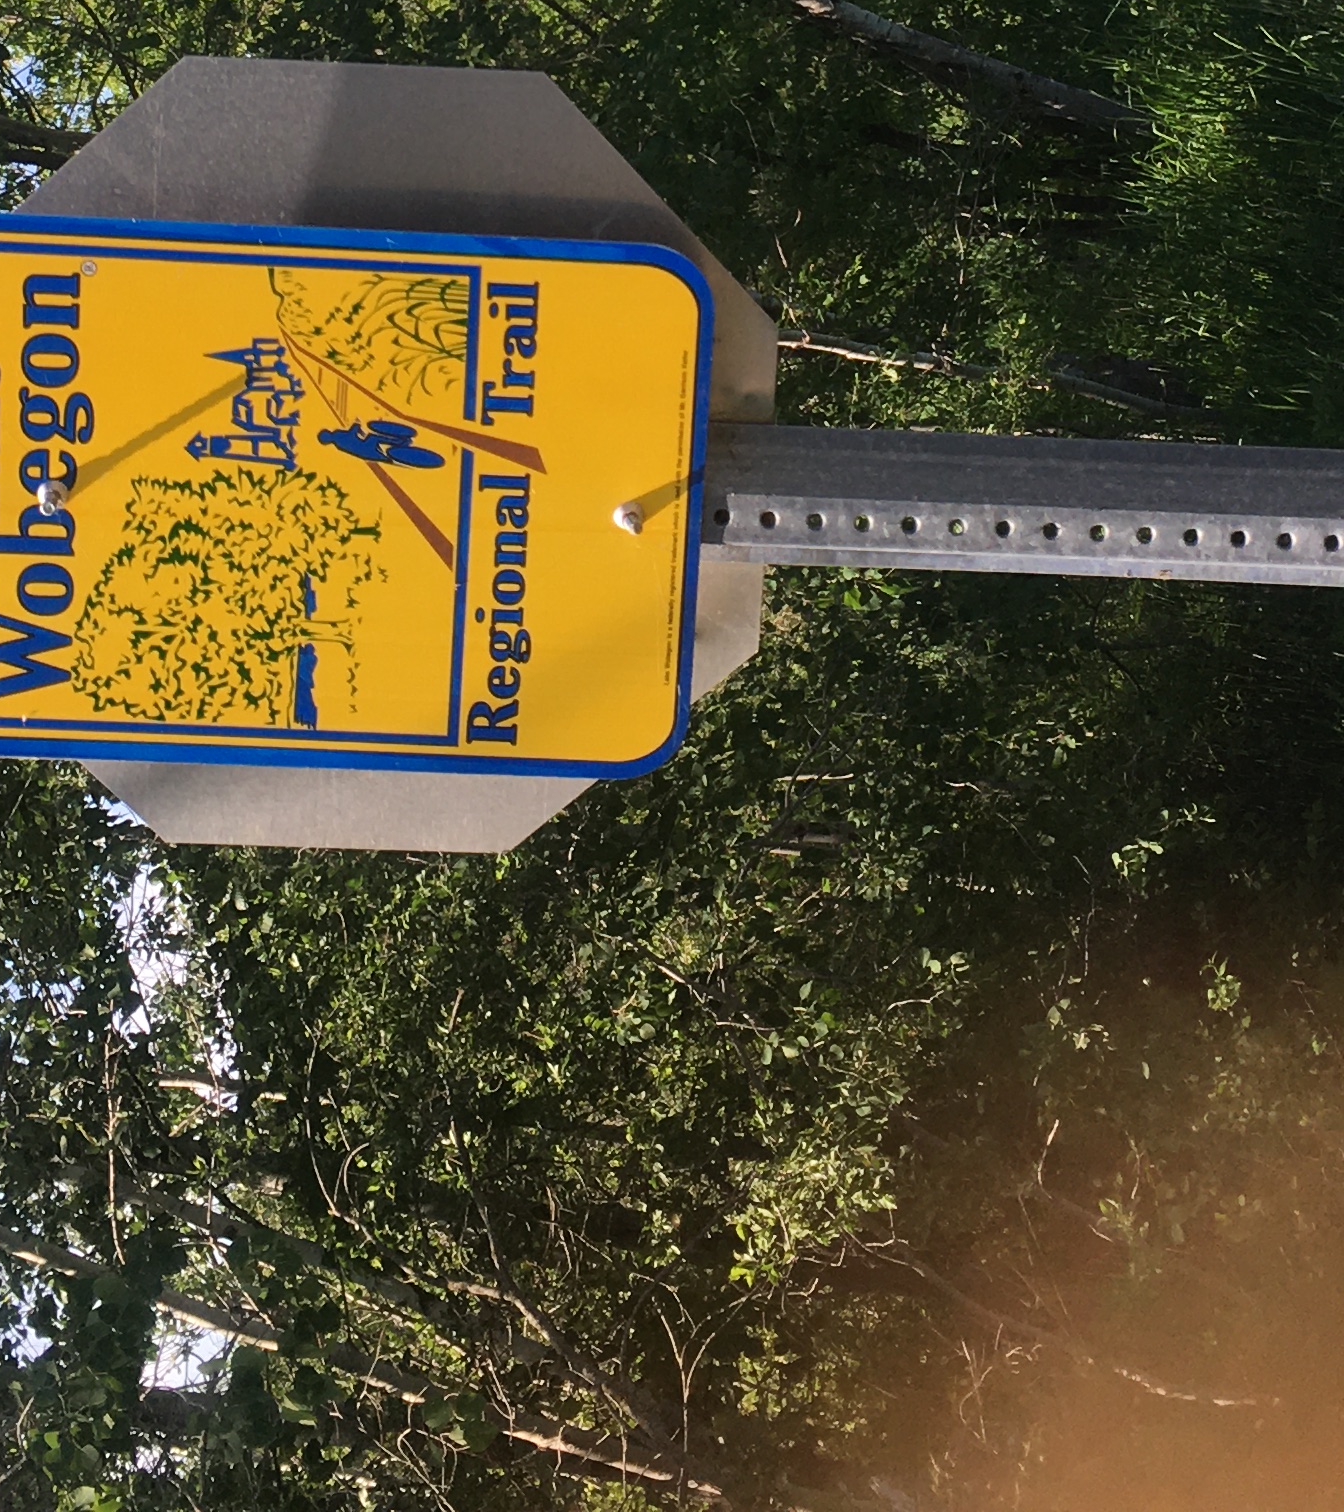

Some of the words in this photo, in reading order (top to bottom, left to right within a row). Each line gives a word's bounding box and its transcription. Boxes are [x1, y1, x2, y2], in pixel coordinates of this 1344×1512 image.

[480, 280, 540, 426] Trail
[465, 472, 532, 747] Regional
[667, 599, 675, 624] federally
[669, 565, 677, 596] registered
